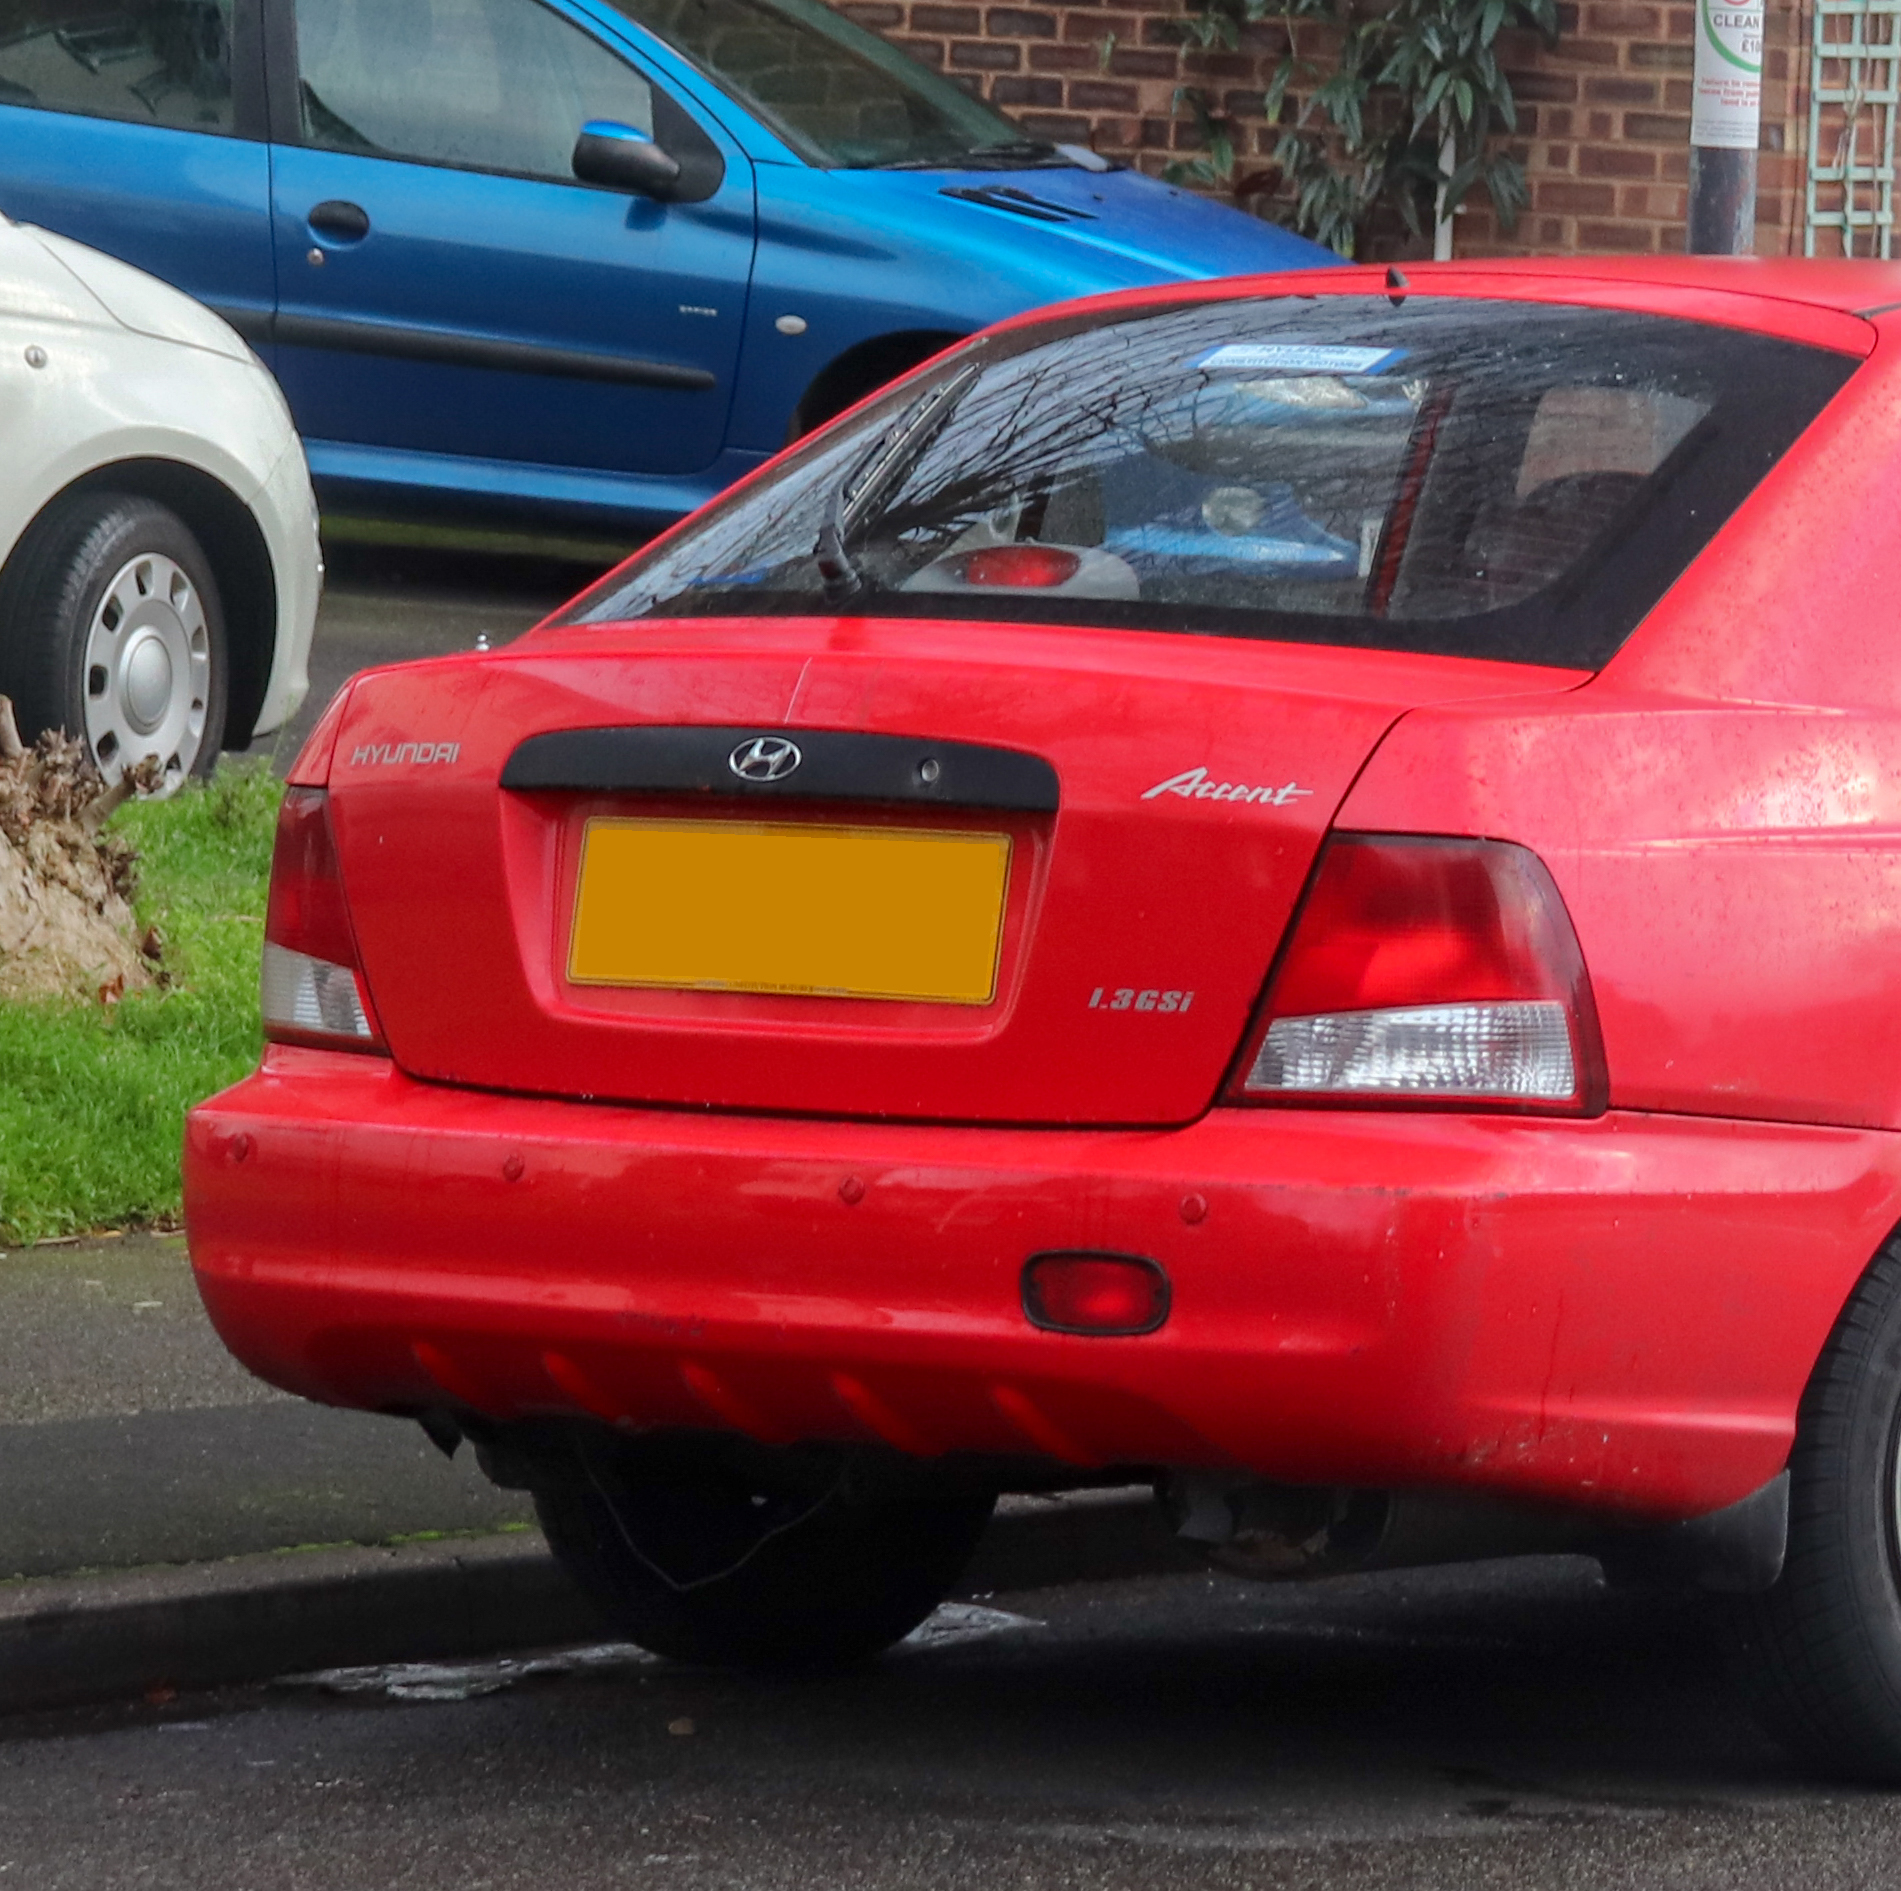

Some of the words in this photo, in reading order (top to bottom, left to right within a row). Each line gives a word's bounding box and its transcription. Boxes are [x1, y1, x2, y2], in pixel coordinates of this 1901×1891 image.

[350, 742, 460, 766] HYUNDAI
[1140, 766, 1314, 807] Accent
[1088, 986, 1195, 1013] 1.3GSi
